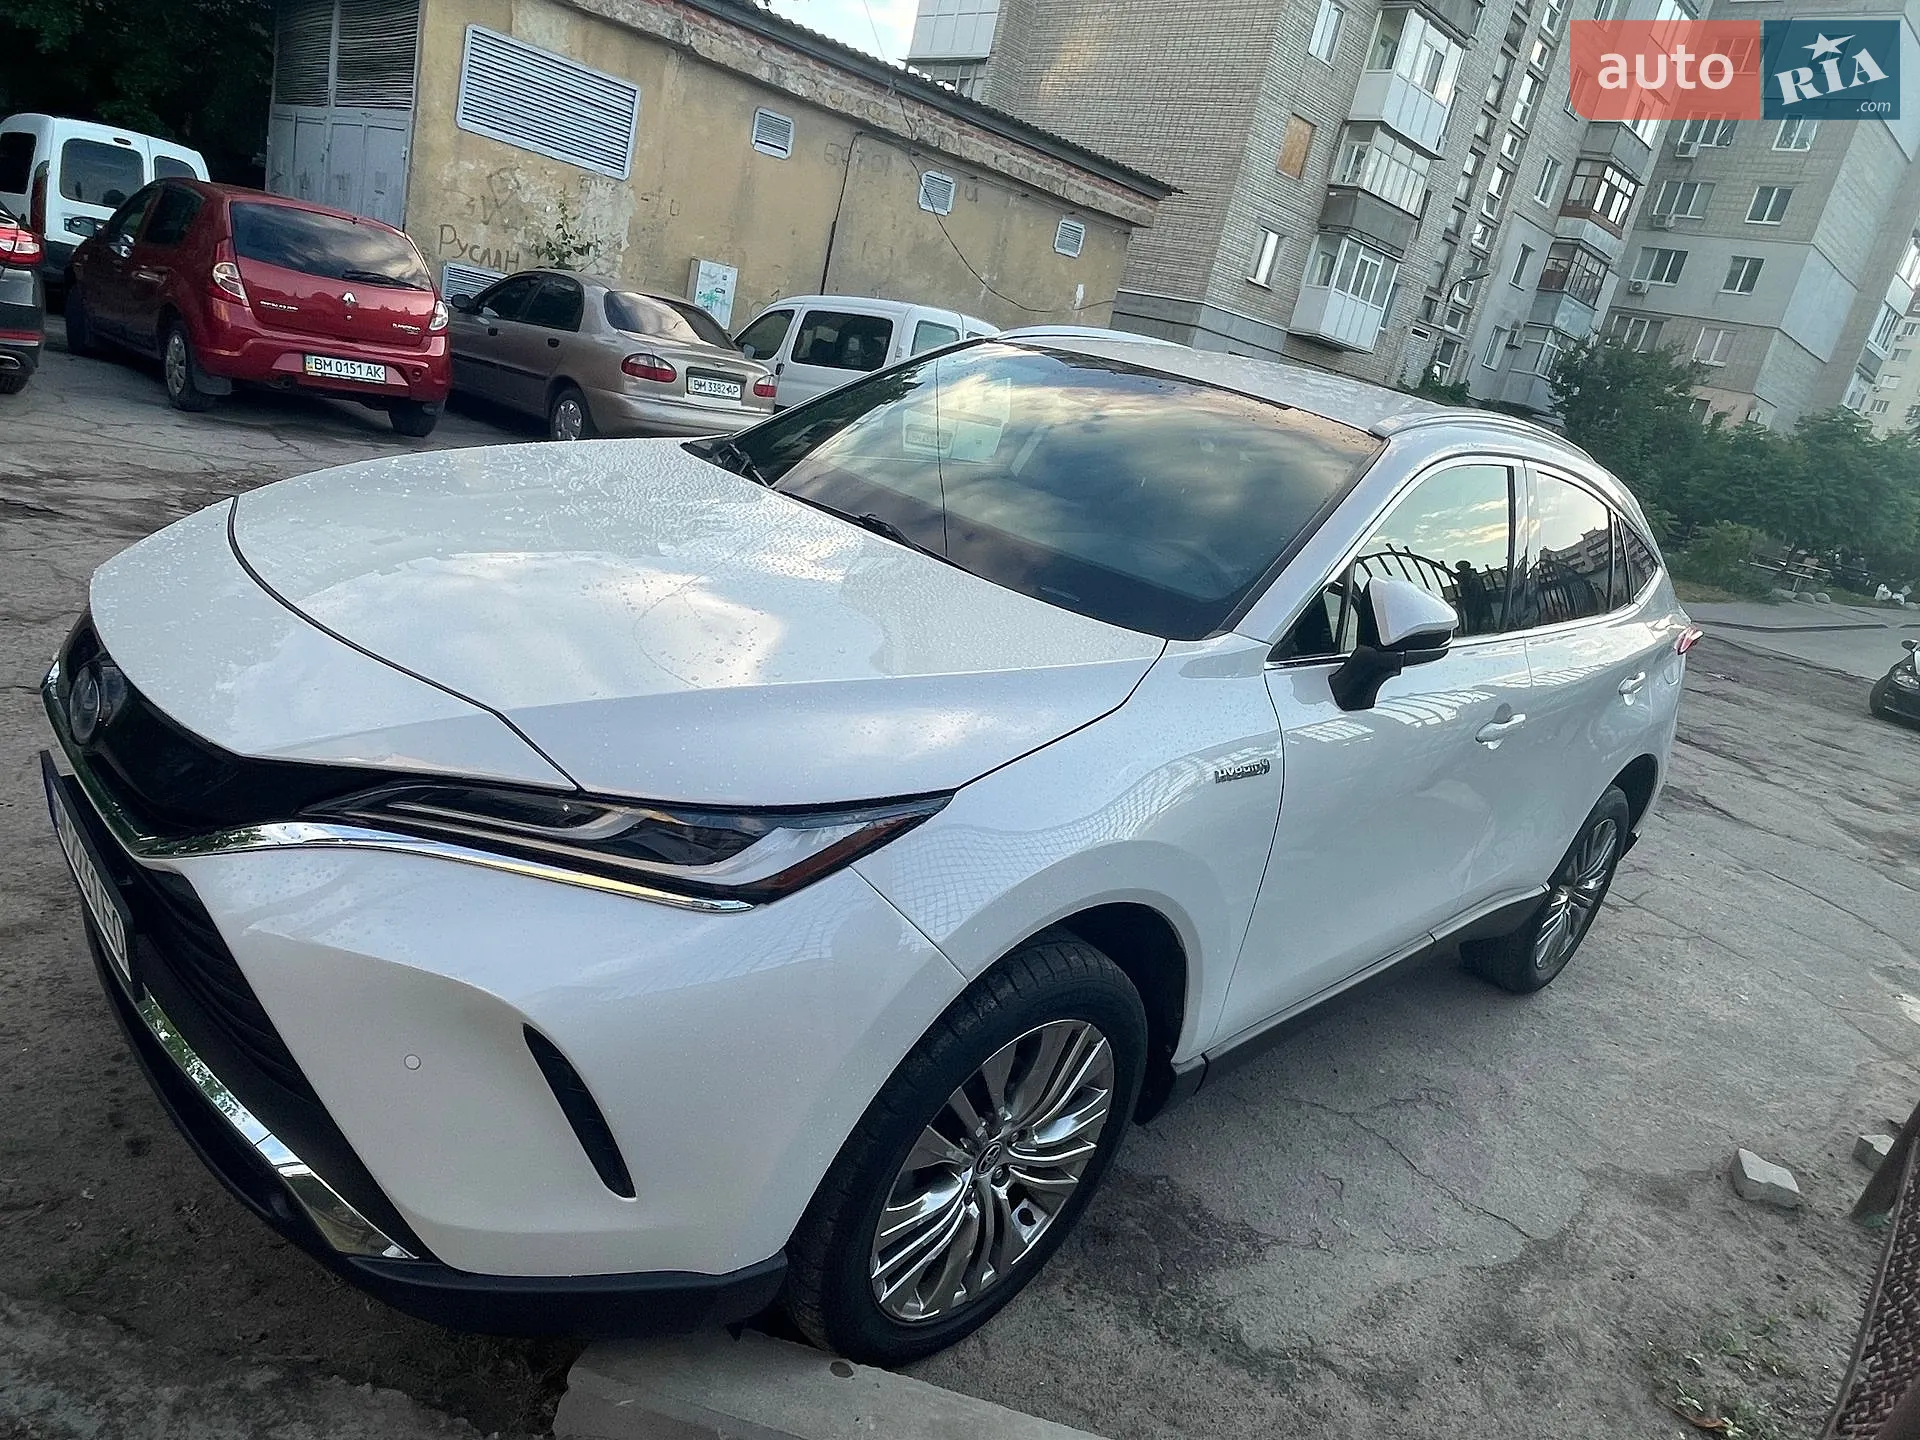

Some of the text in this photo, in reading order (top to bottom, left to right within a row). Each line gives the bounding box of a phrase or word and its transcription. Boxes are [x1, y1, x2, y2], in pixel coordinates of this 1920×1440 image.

[314, 358, 333, 372] BM
[335, 360, 363, 376] 0151
[365, 365, 382, 379] AK
